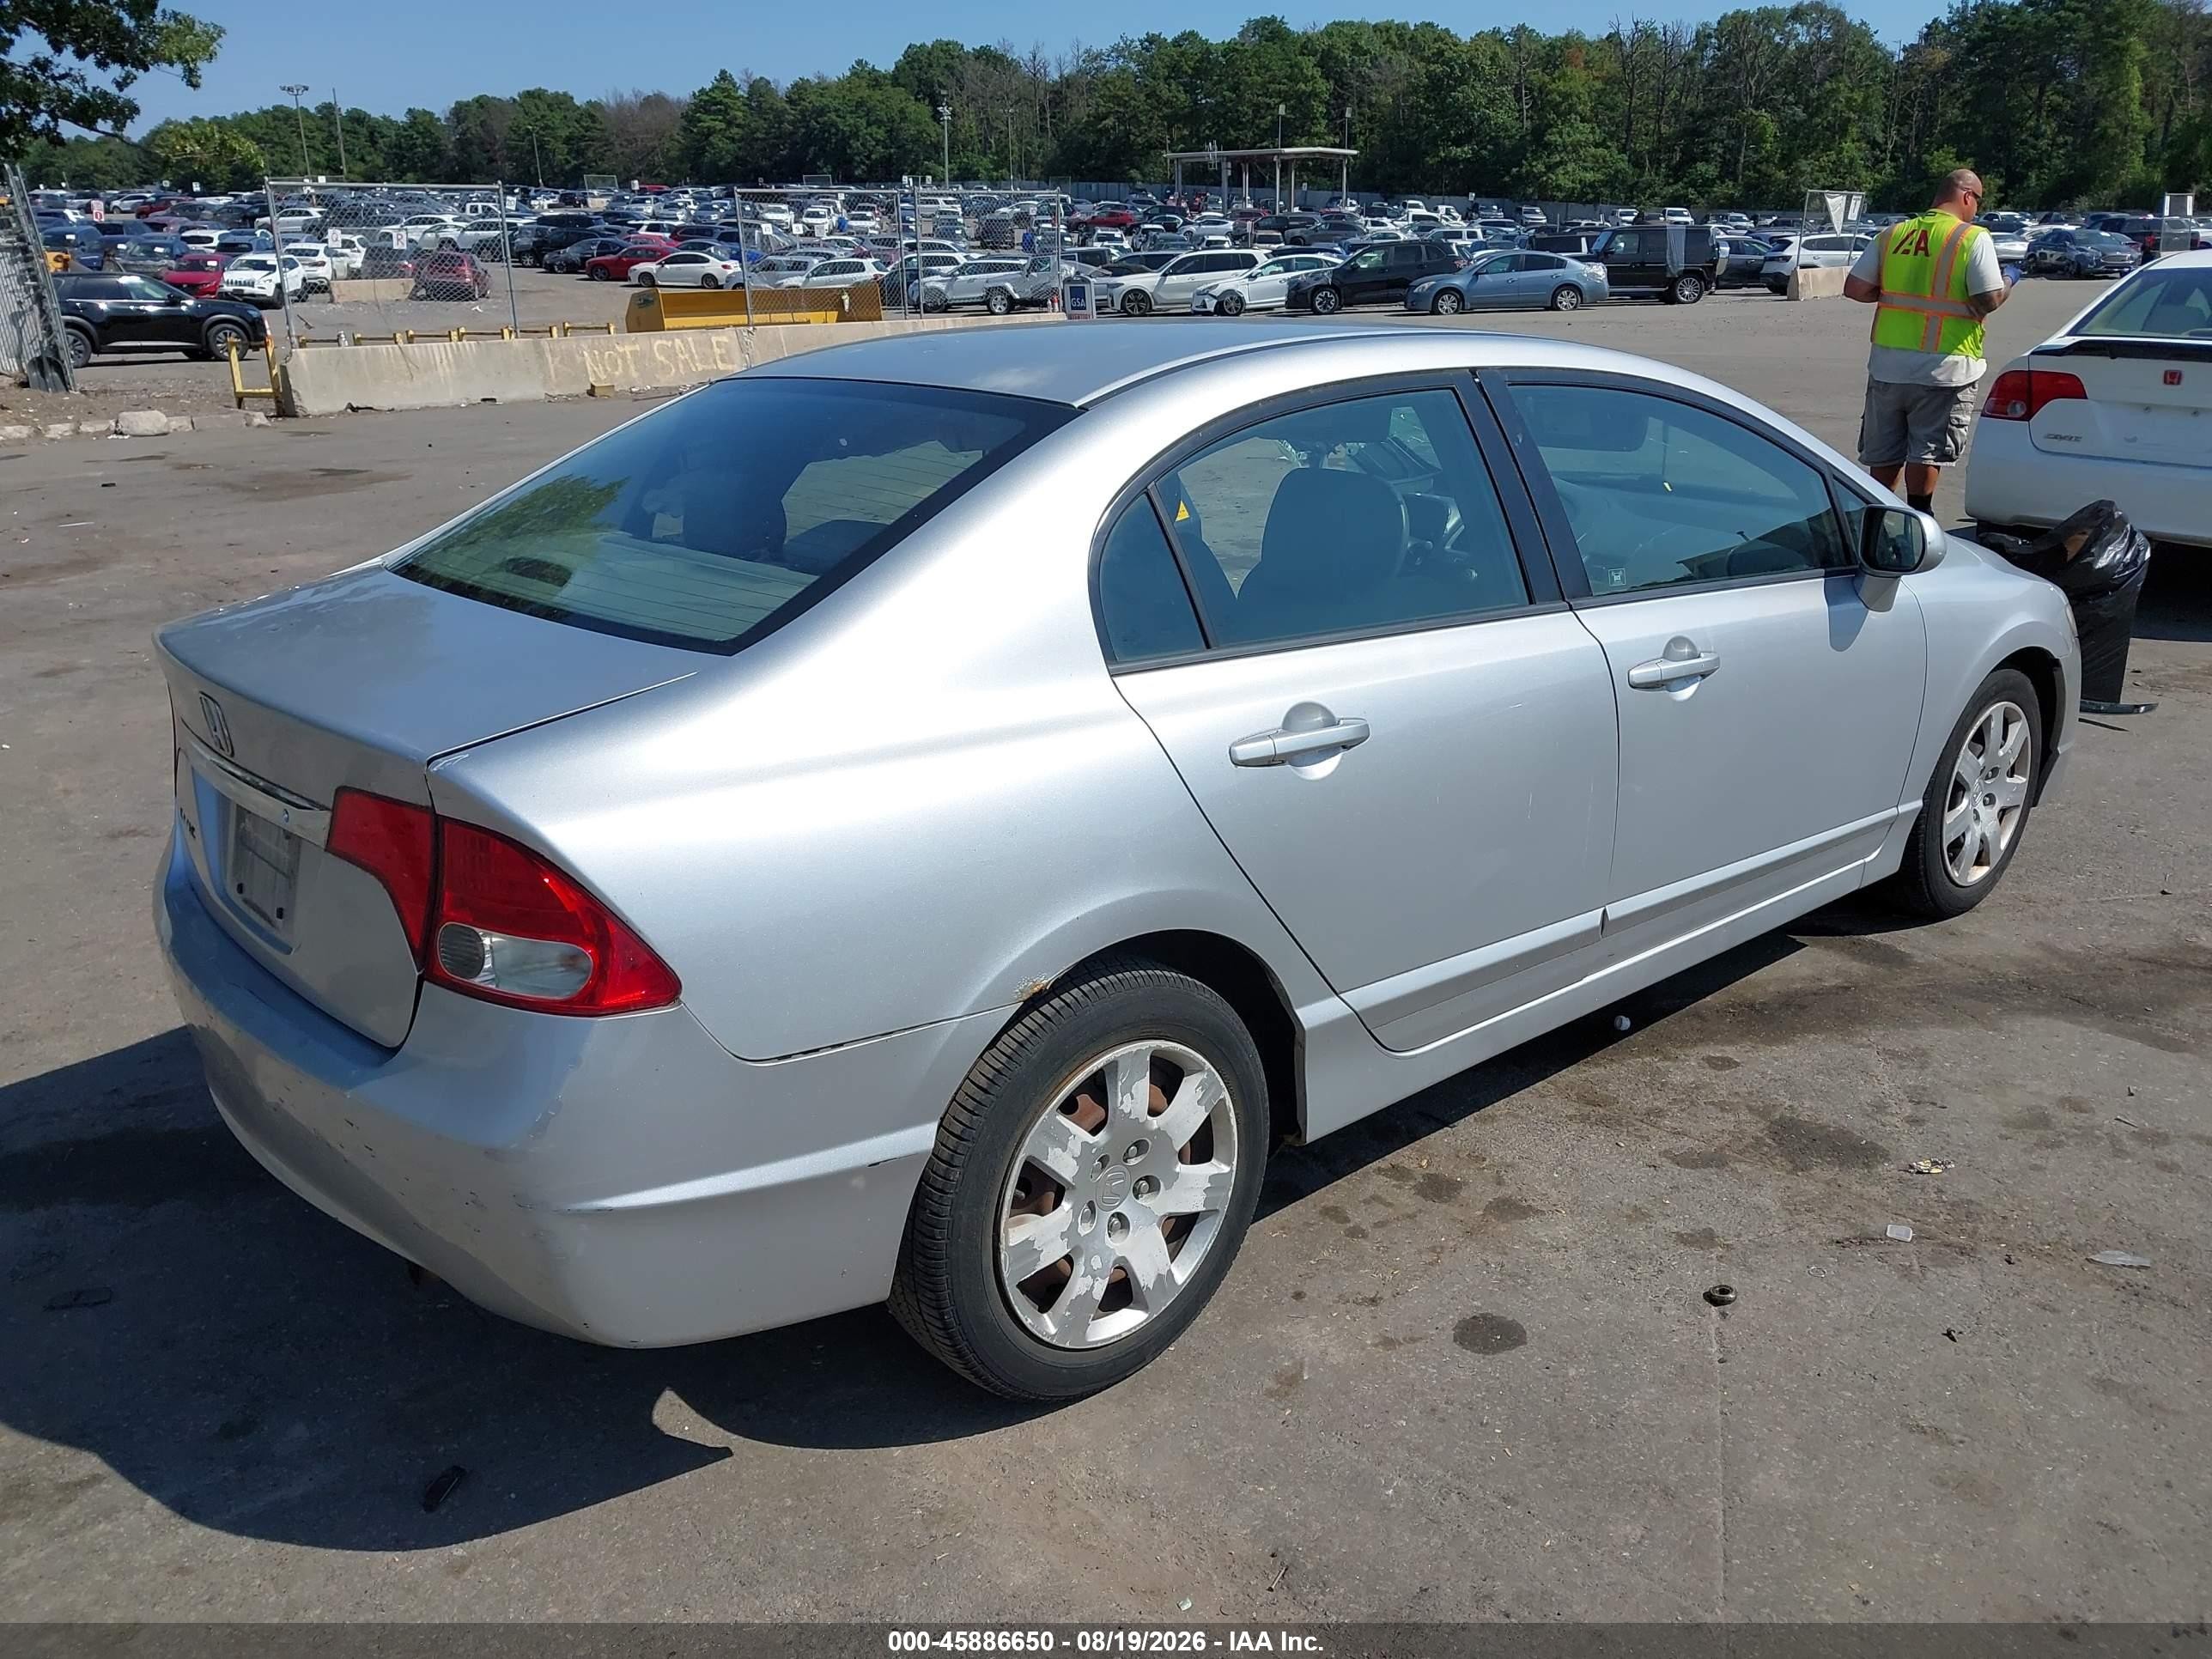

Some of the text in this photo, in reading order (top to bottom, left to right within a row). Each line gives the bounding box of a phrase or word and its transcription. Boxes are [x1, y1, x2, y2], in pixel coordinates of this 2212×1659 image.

[396, 233, 404, 246] R
[1071, 297, 1086, 307] GSA
[583, 336, 737, 385] NOT SALE
